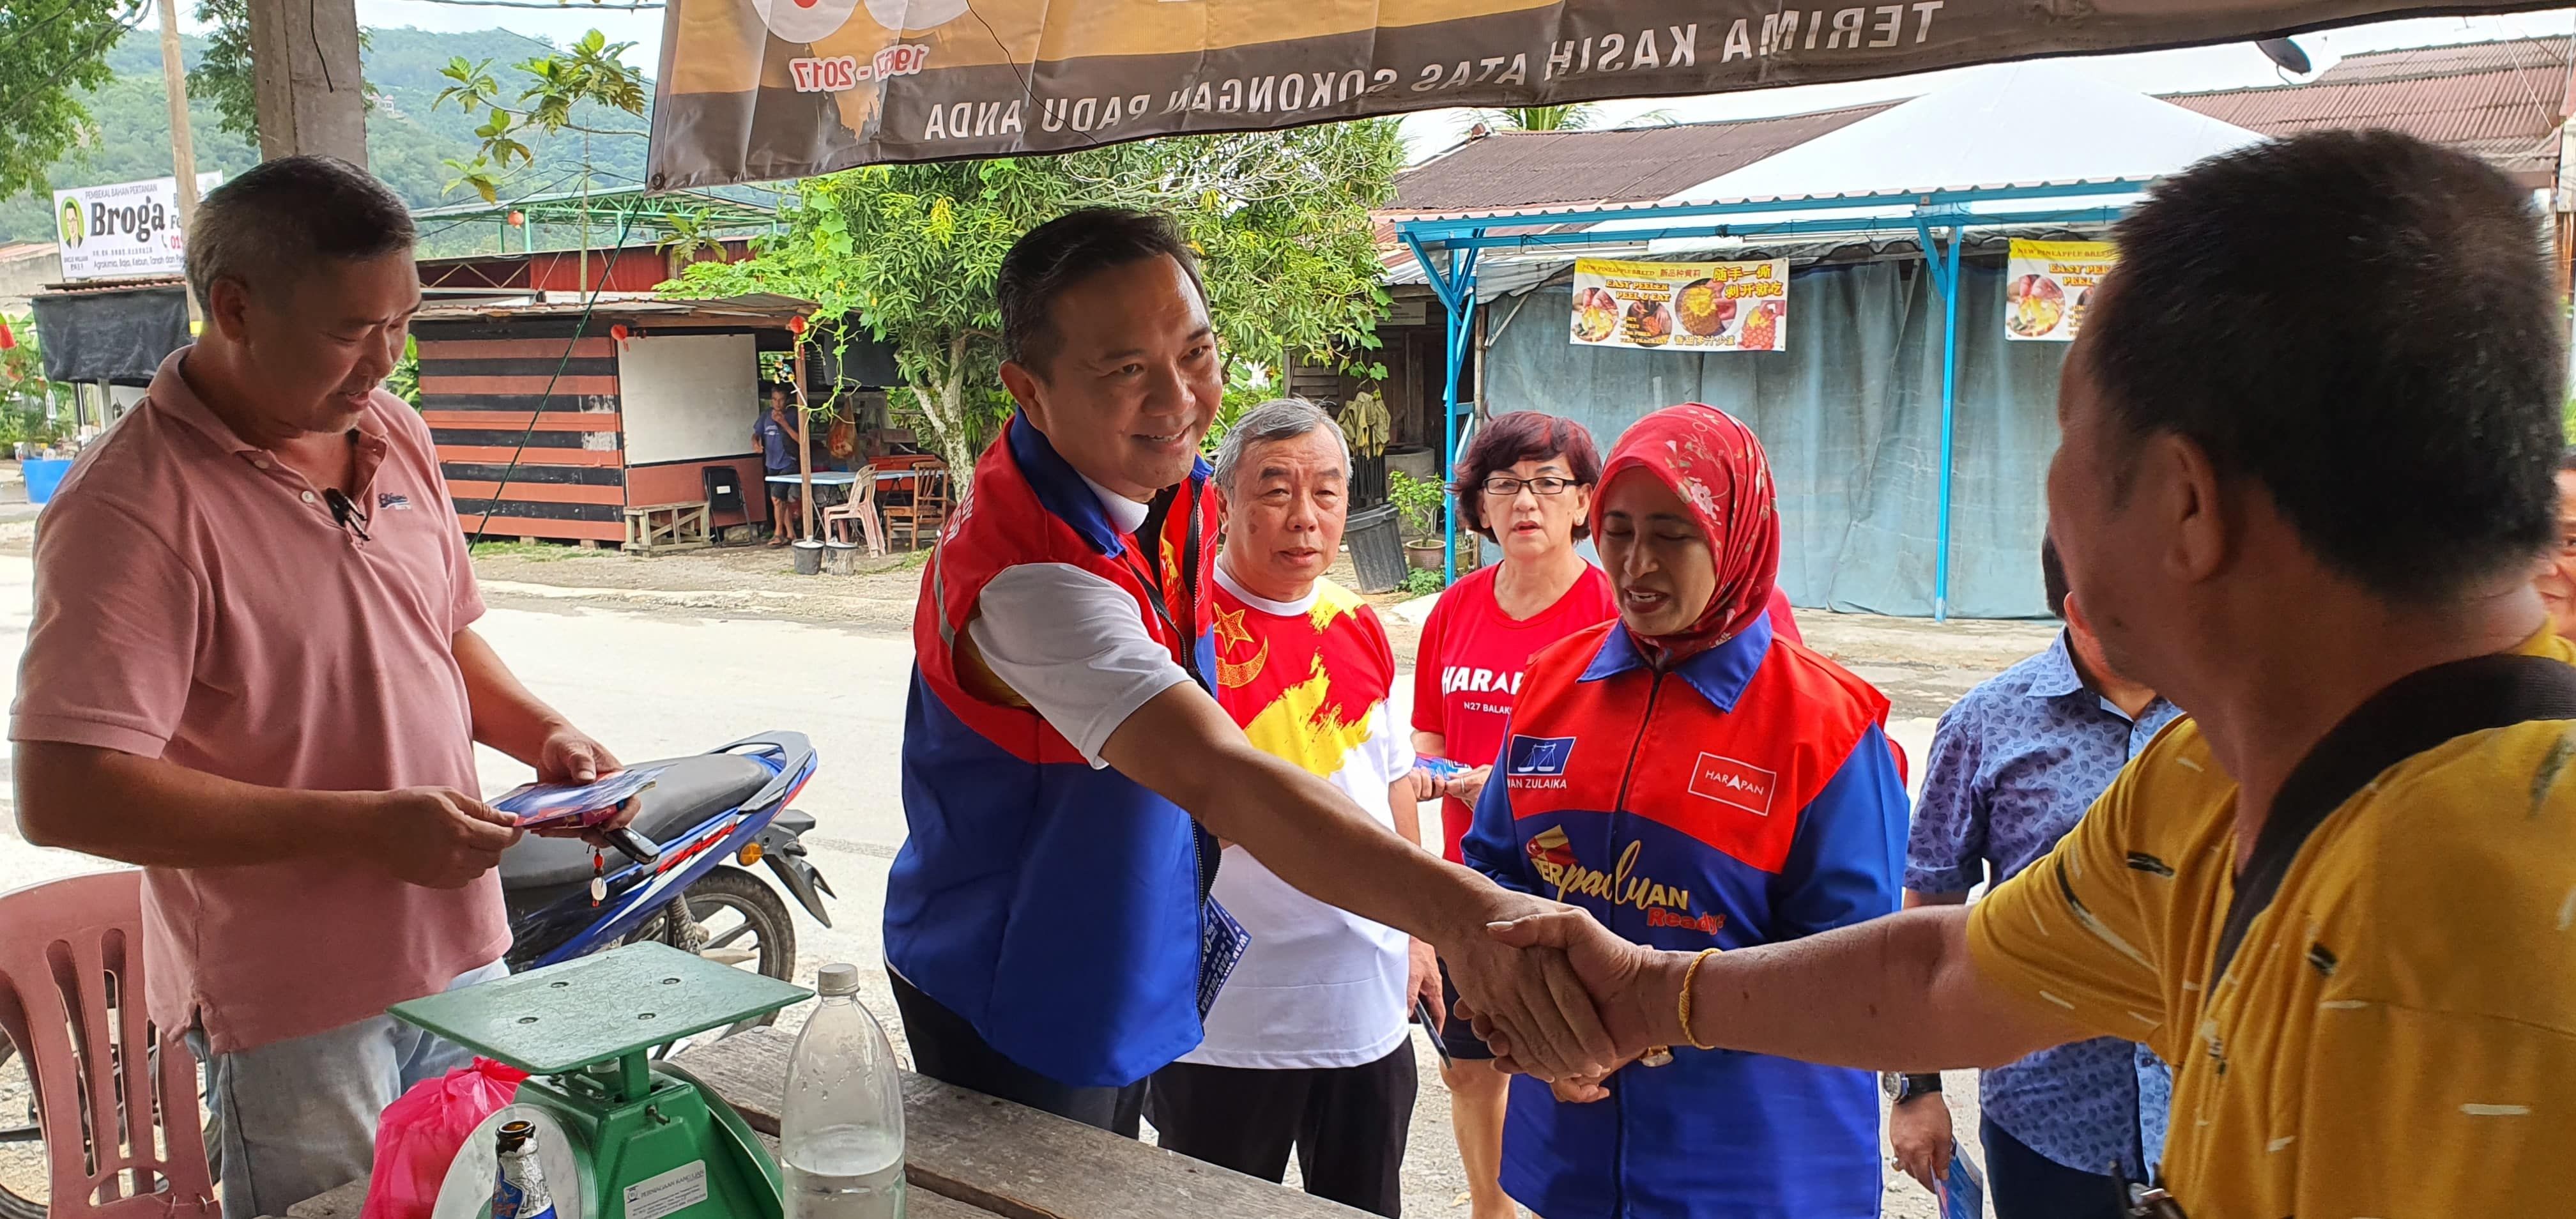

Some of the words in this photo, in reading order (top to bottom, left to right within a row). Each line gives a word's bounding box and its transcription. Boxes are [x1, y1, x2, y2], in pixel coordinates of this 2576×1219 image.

[91, 197, 165, 243] Broga
[2049, 263, 2083, 273] EASY
[1606, 279, 1631, 289] EASY
[1634, 280, 1669, 291] PEELER
[2063, 276, 2094, 286] PEEL
[1616, 291, 1639, 301] PEEL
[1650, 293, 1671, 302] EAT
[1464, 702, 1481, 711] N27
[1525, 779, 1567, 789] ZULAIKA
[1705, 769, 1765, 796] HARAPAN
